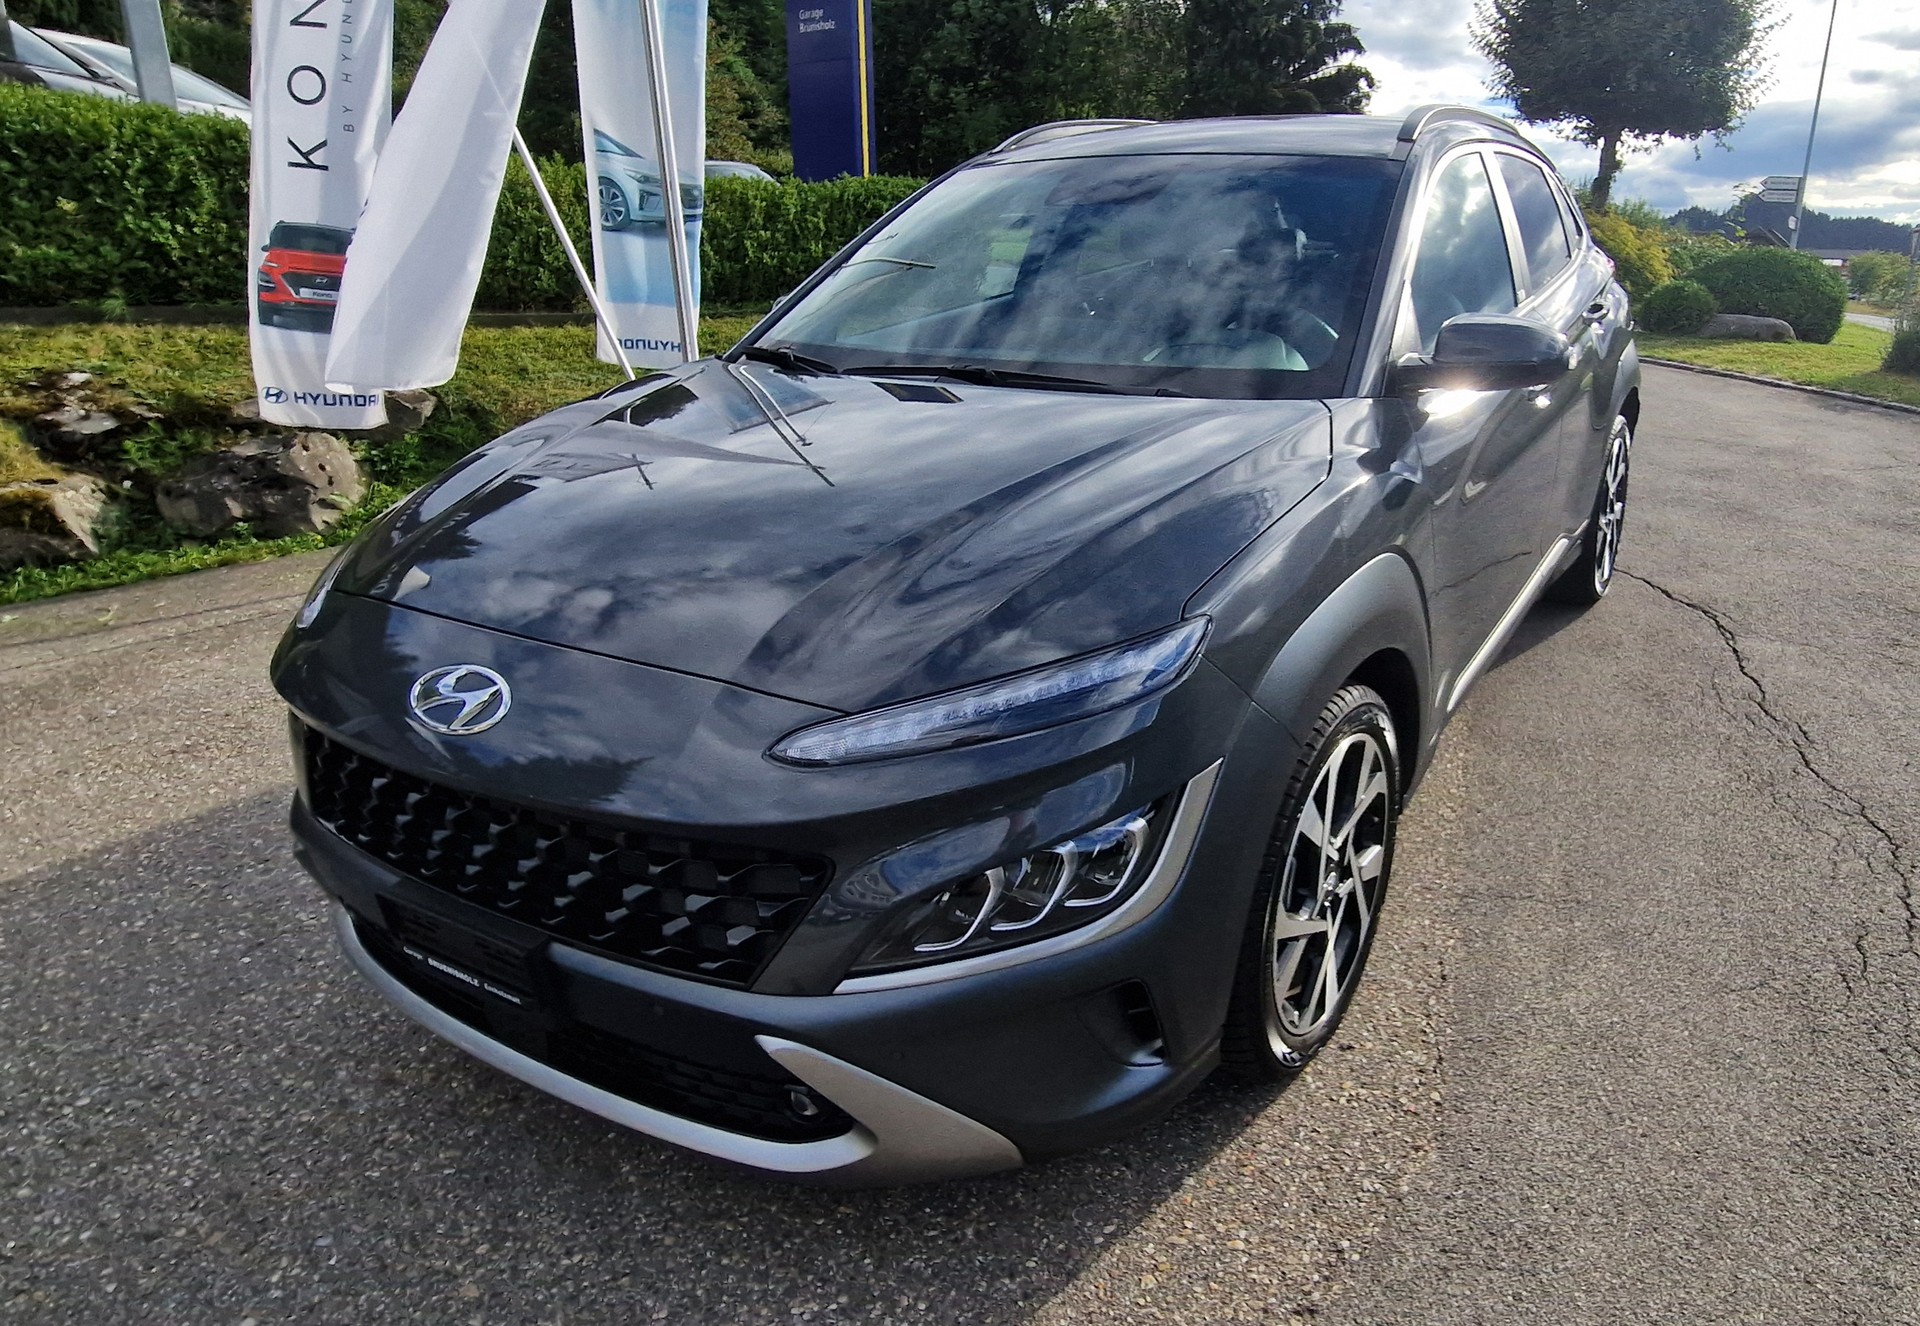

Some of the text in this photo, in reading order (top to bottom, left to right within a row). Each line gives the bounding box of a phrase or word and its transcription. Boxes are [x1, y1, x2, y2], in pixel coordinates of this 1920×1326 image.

[799, 9, 824, 20] Garage
[342, 105, 355, 132] BY
[294, 391, 379, 407] HYUNDAI
